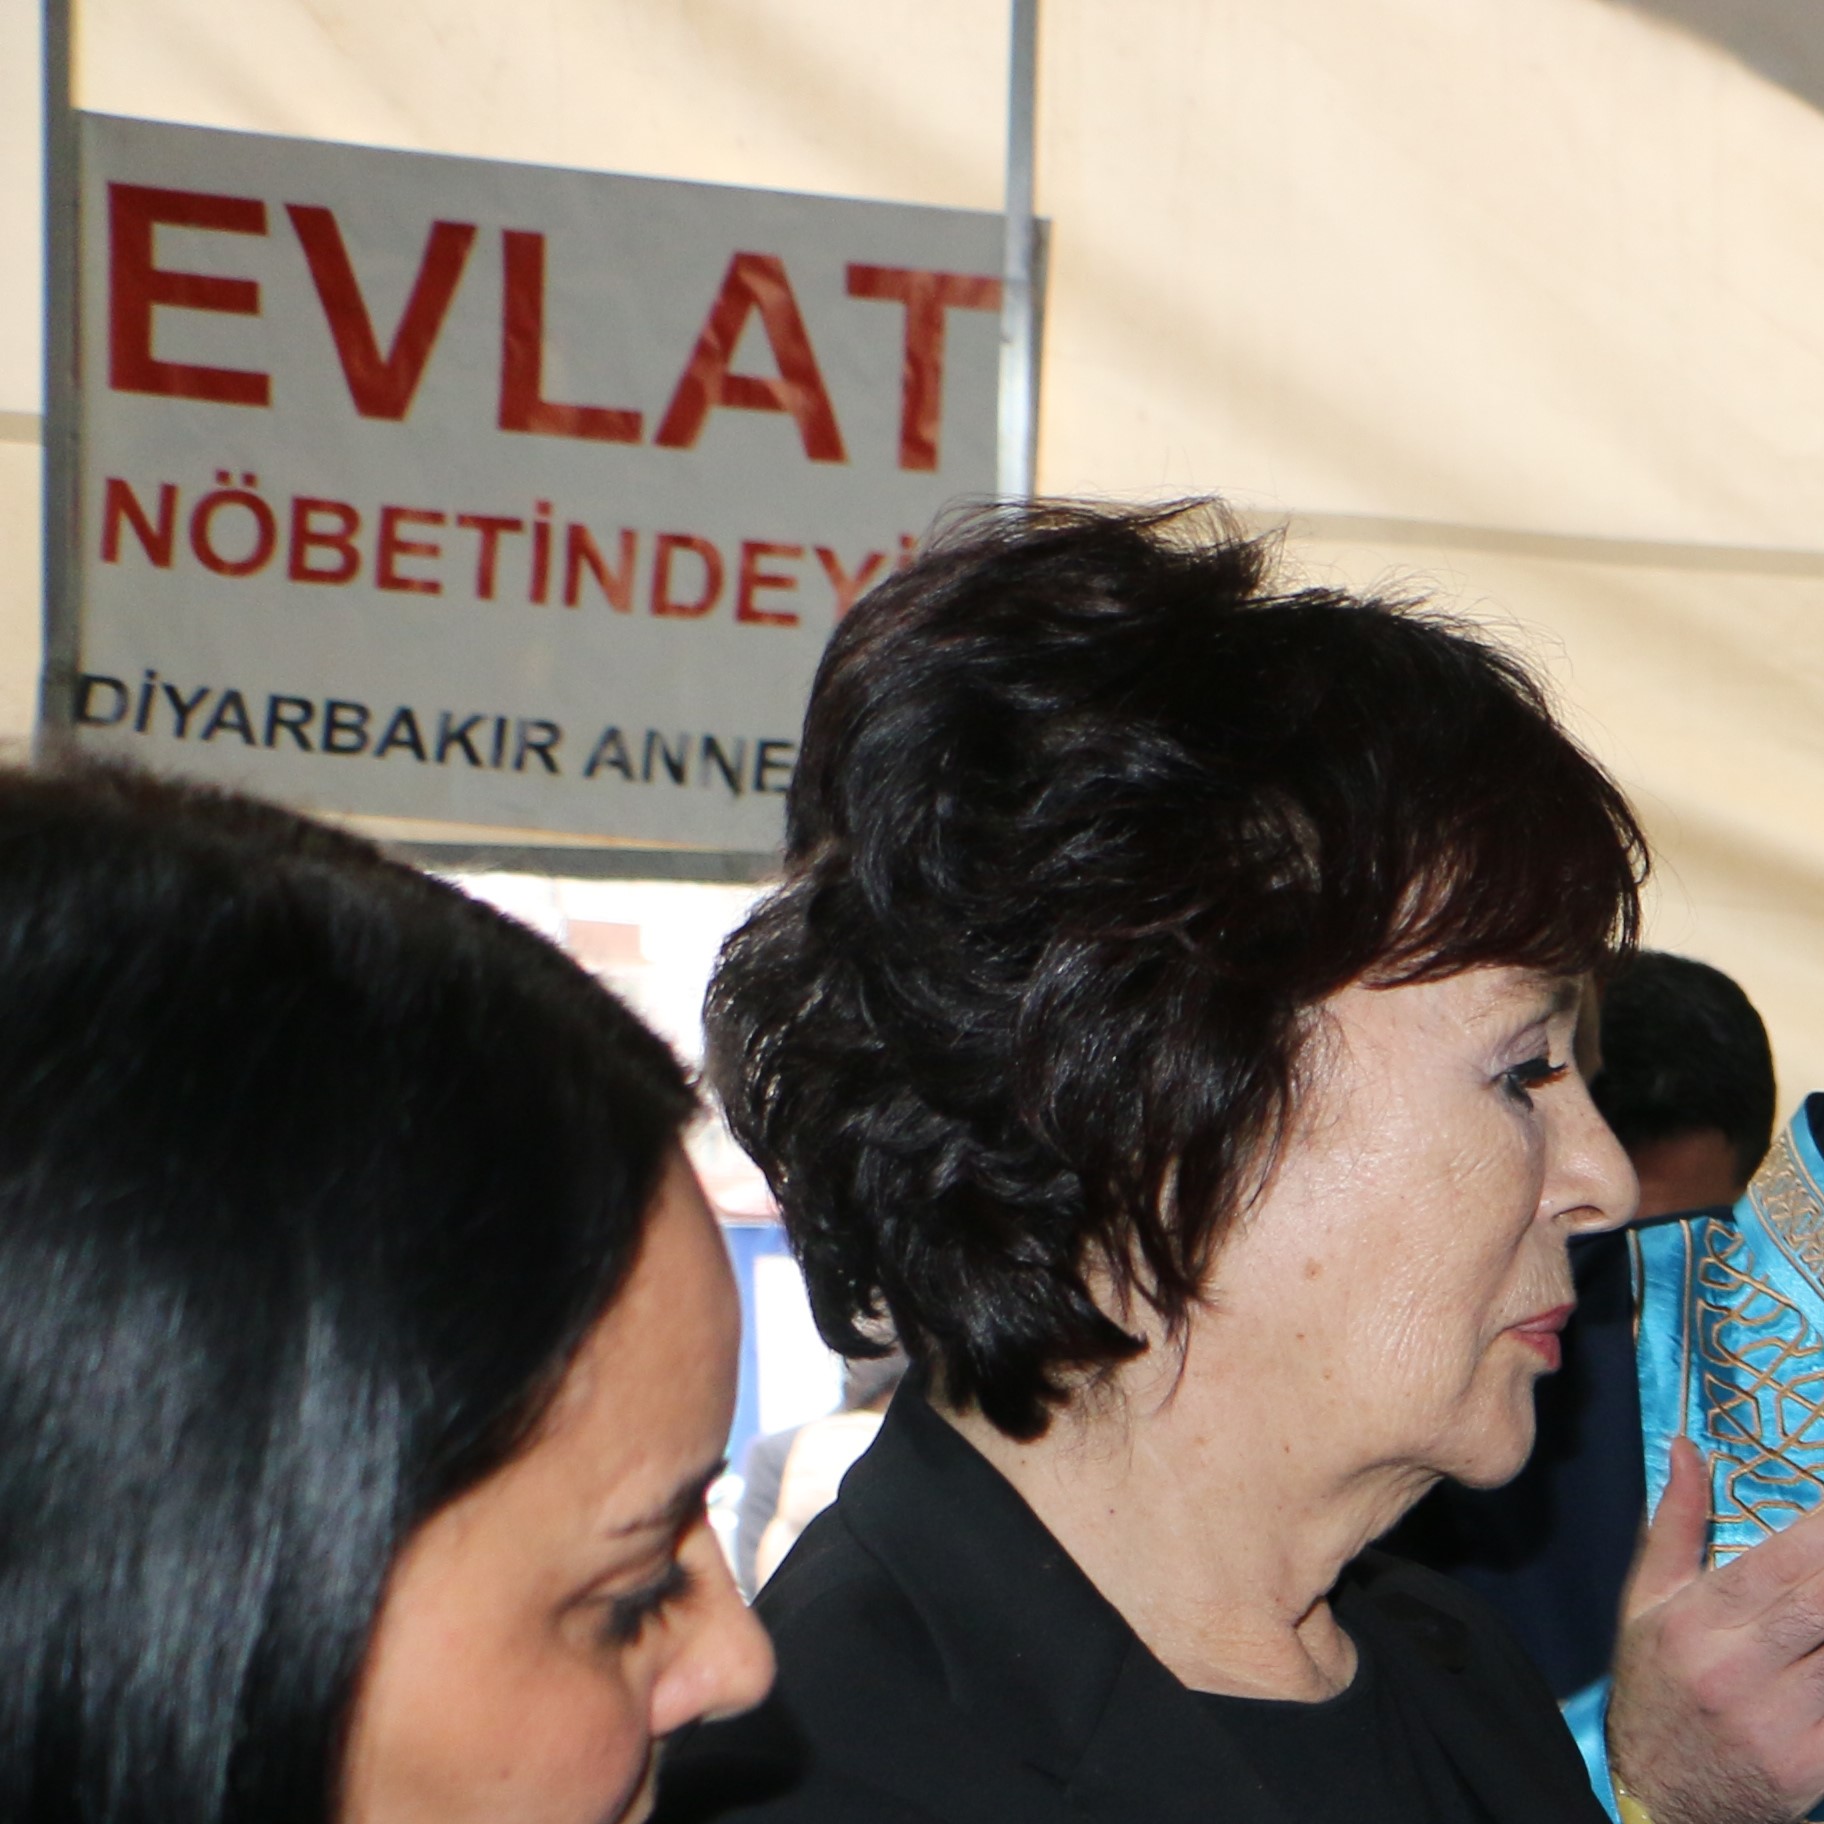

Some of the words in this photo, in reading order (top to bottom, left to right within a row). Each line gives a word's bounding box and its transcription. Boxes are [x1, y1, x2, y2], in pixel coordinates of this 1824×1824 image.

[106, 180, 1003, 474] EVLAT
[75, 668, 563, 775] DİYARBAKIR
[584, 724, 796, 798] ANNE
